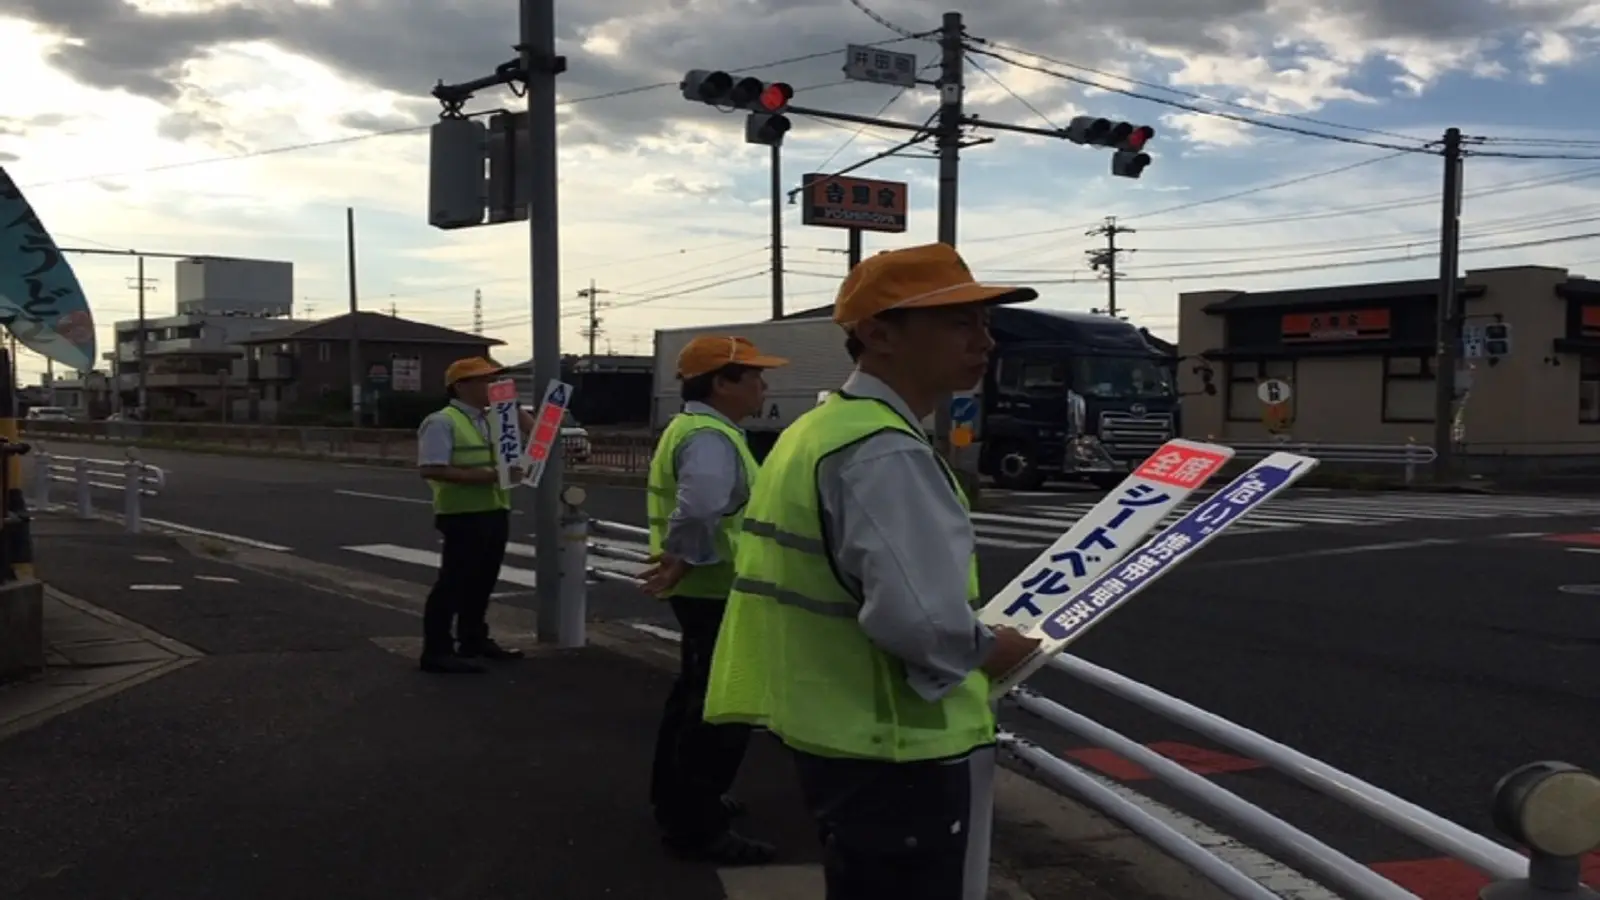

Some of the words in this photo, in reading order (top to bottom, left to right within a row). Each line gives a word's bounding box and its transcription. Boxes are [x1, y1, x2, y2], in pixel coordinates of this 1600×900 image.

[1143, 451, 1214, 482] 全席
[1003, 484, 1171, 617] シートベルト
